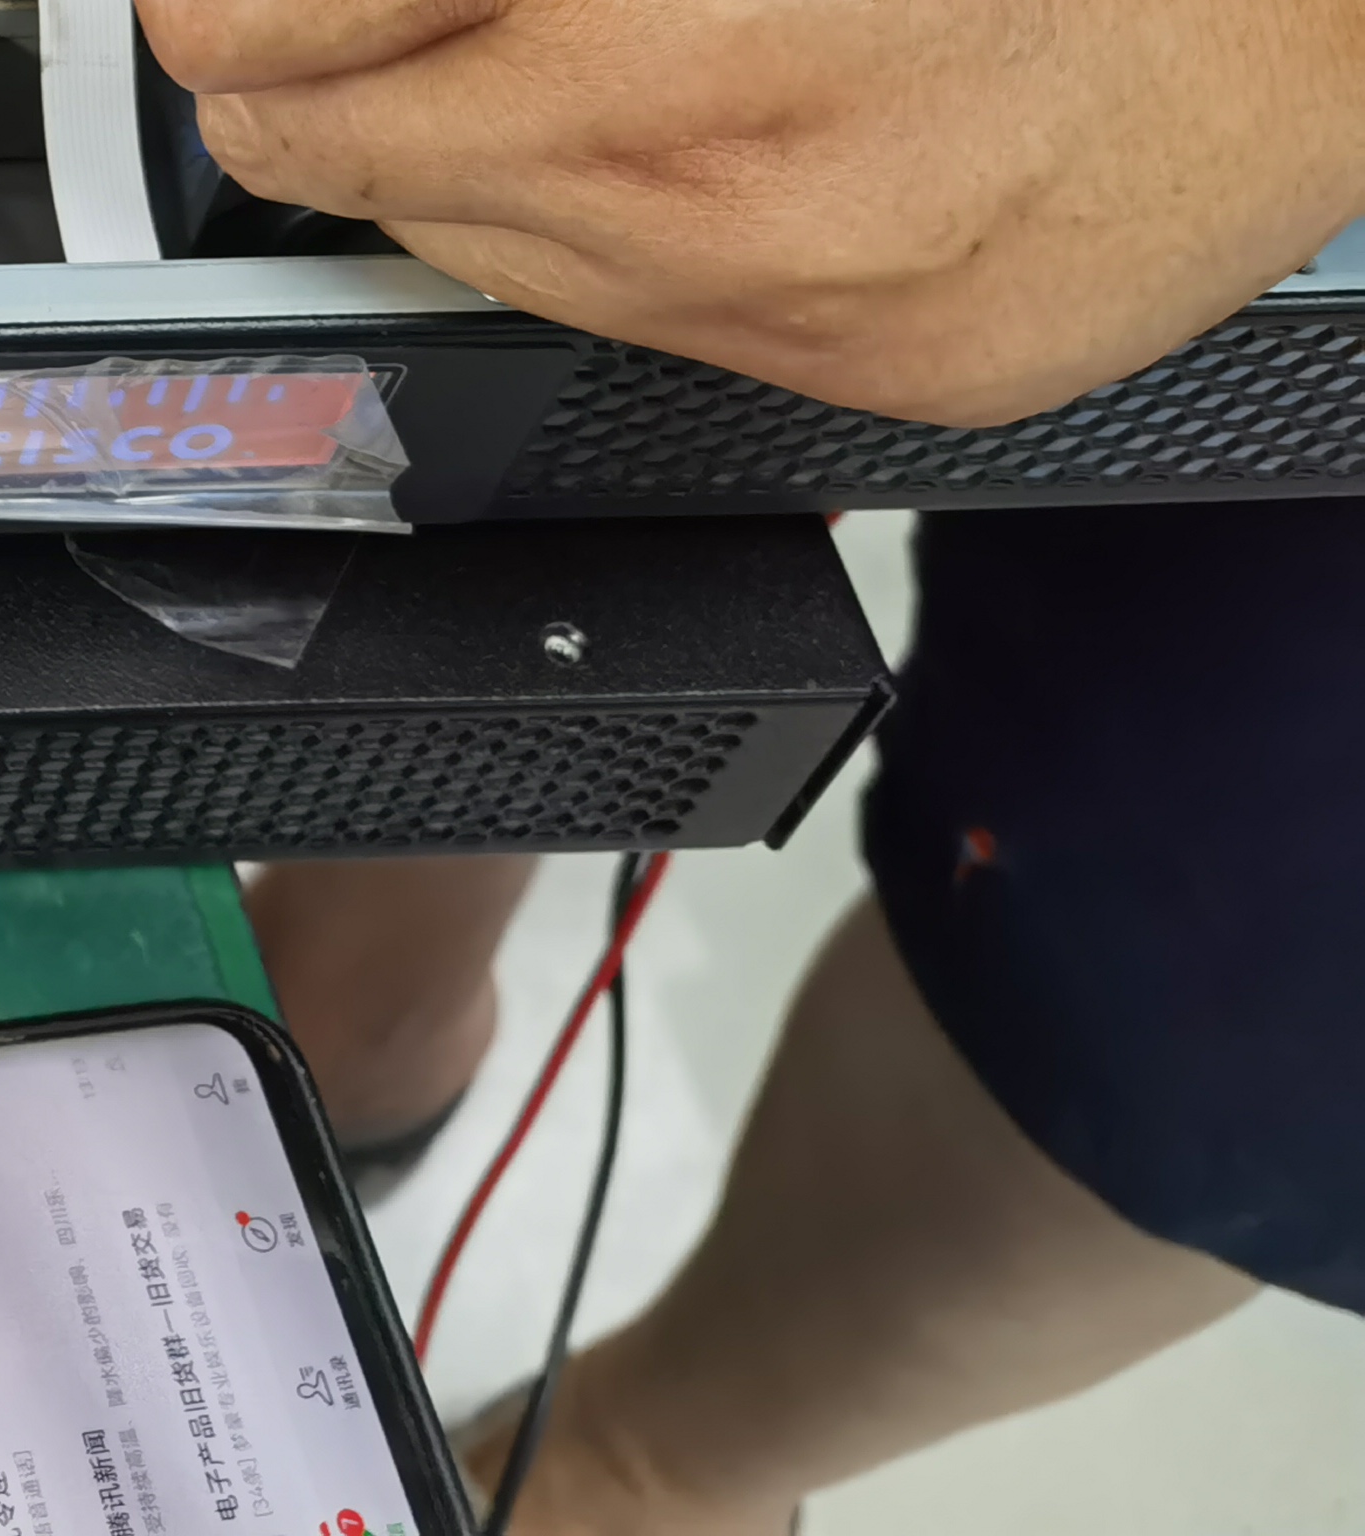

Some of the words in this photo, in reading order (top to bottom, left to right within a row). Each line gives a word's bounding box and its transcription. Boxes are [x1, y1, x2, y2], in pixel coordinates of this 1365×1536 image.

[279, 1213, 303, 1248] 发现
[329, 1354, 360, 1410] 通讯录
[81, 1429, 134, 1536] 腾讯新闻
